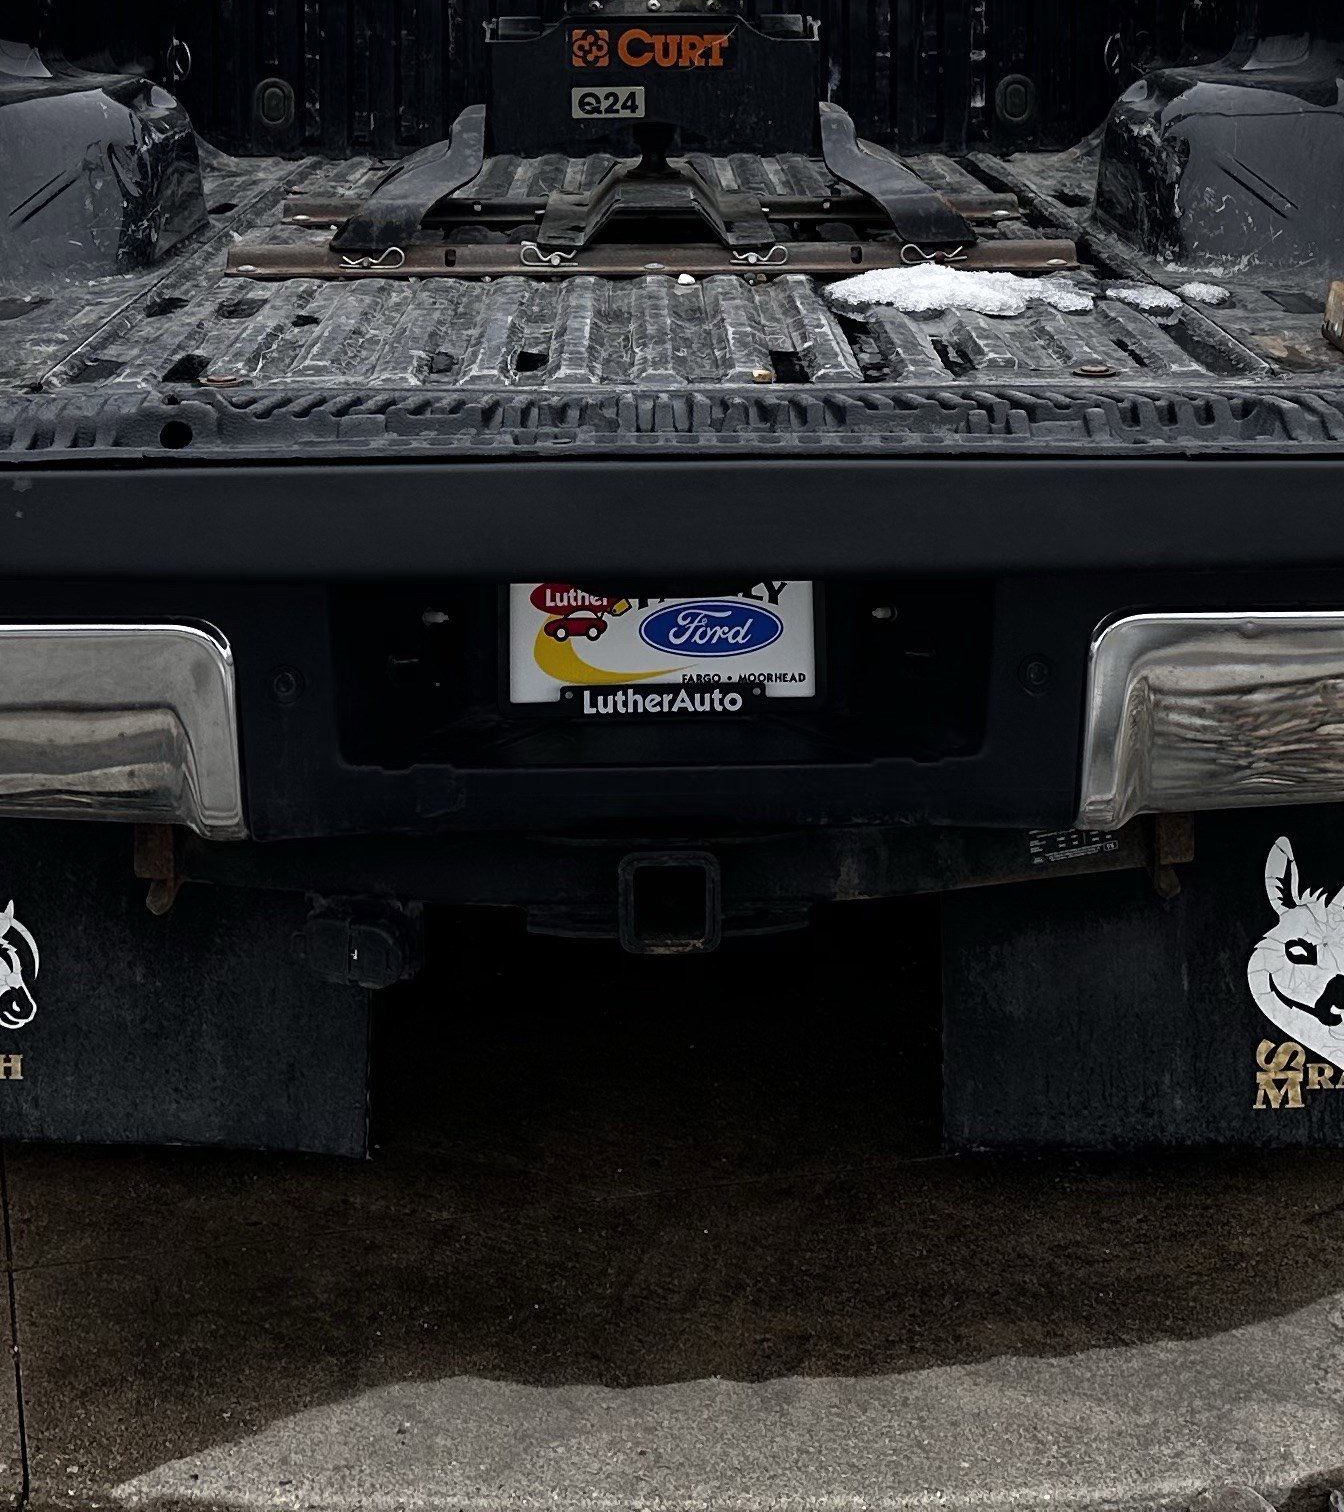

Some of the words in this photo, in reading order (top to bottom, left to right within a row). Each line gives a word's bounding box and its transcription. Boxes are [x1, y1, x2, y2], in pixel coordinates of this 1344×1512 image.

[618, 29, 729, 67] CURT
[578, 91, 639, 114] Q24
[668, 609, 754, 645] Ford
[682, 673, 721, 684] FARGO
[738, 672, 806, 684] MOORHEAD
[583, 688, 743, 714] LutherAuto
